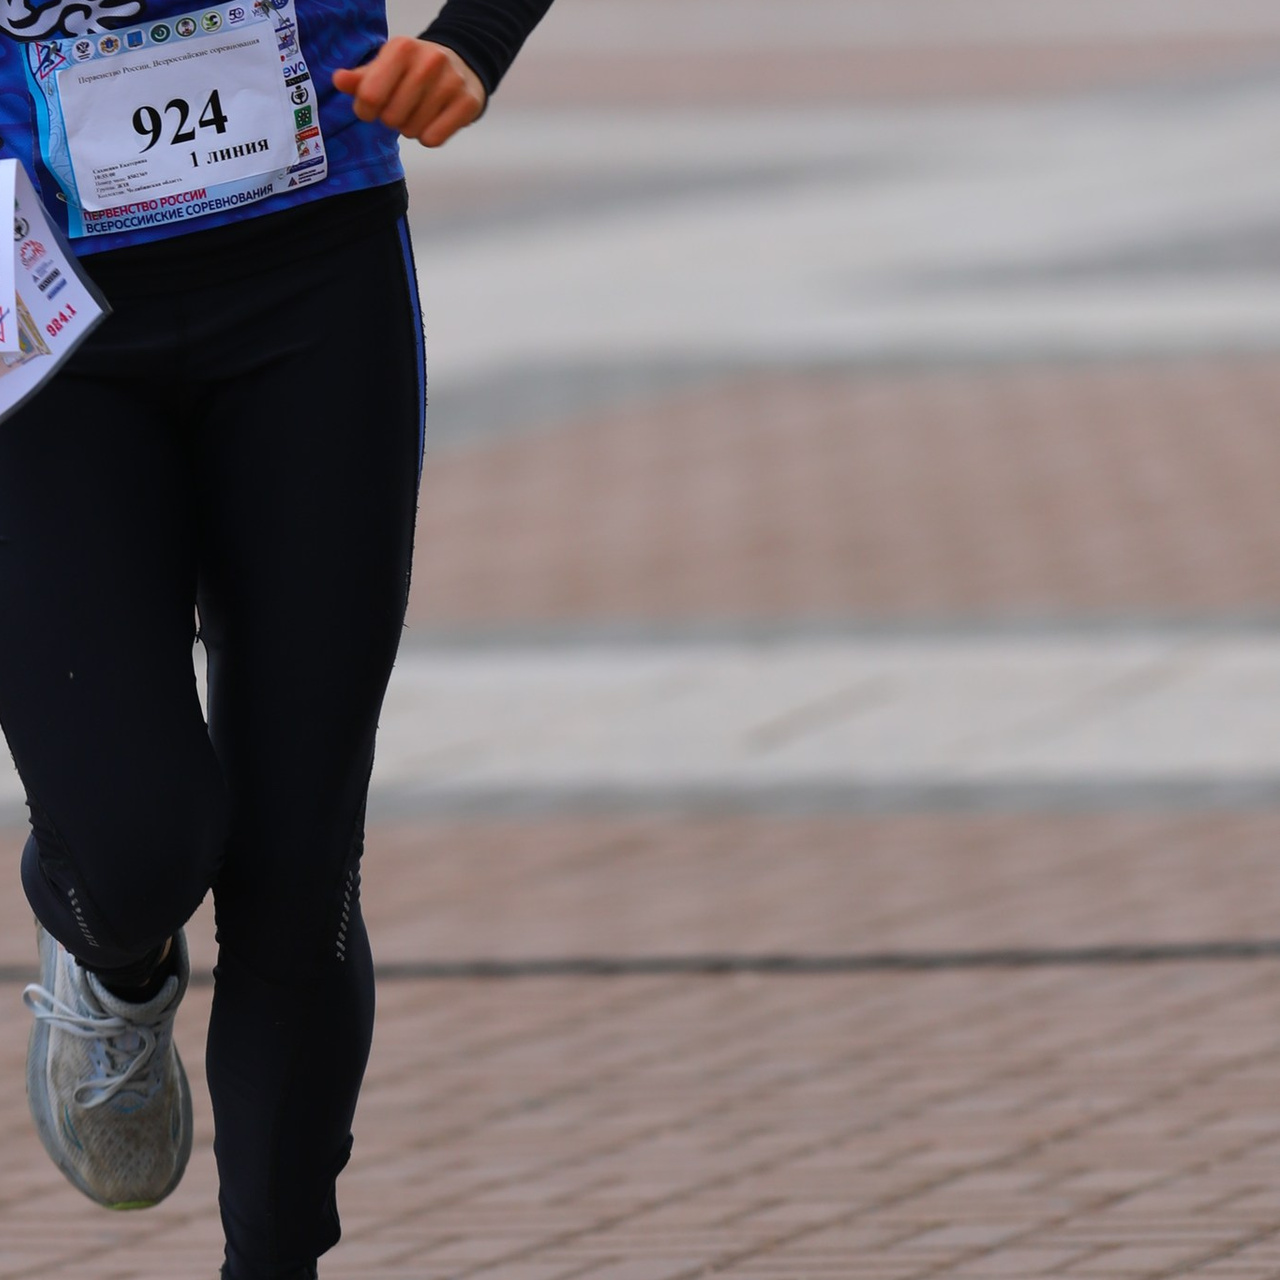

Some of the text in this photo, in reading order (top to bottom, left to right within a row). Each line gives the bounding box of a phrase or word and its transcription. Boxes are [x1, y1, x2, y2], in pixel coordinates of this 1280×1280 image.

[283, 61, 306, 78] evo
[132, 89, 228, 153] 924
[190, 151, 199, 168] 1
[206, 139, 270, 165] линия
[84, 188, 208, 220] ПЕРВЕНСТВО РОССИИ
[186, 184, 274, 215] СОРЕВНОВАНИЯ
